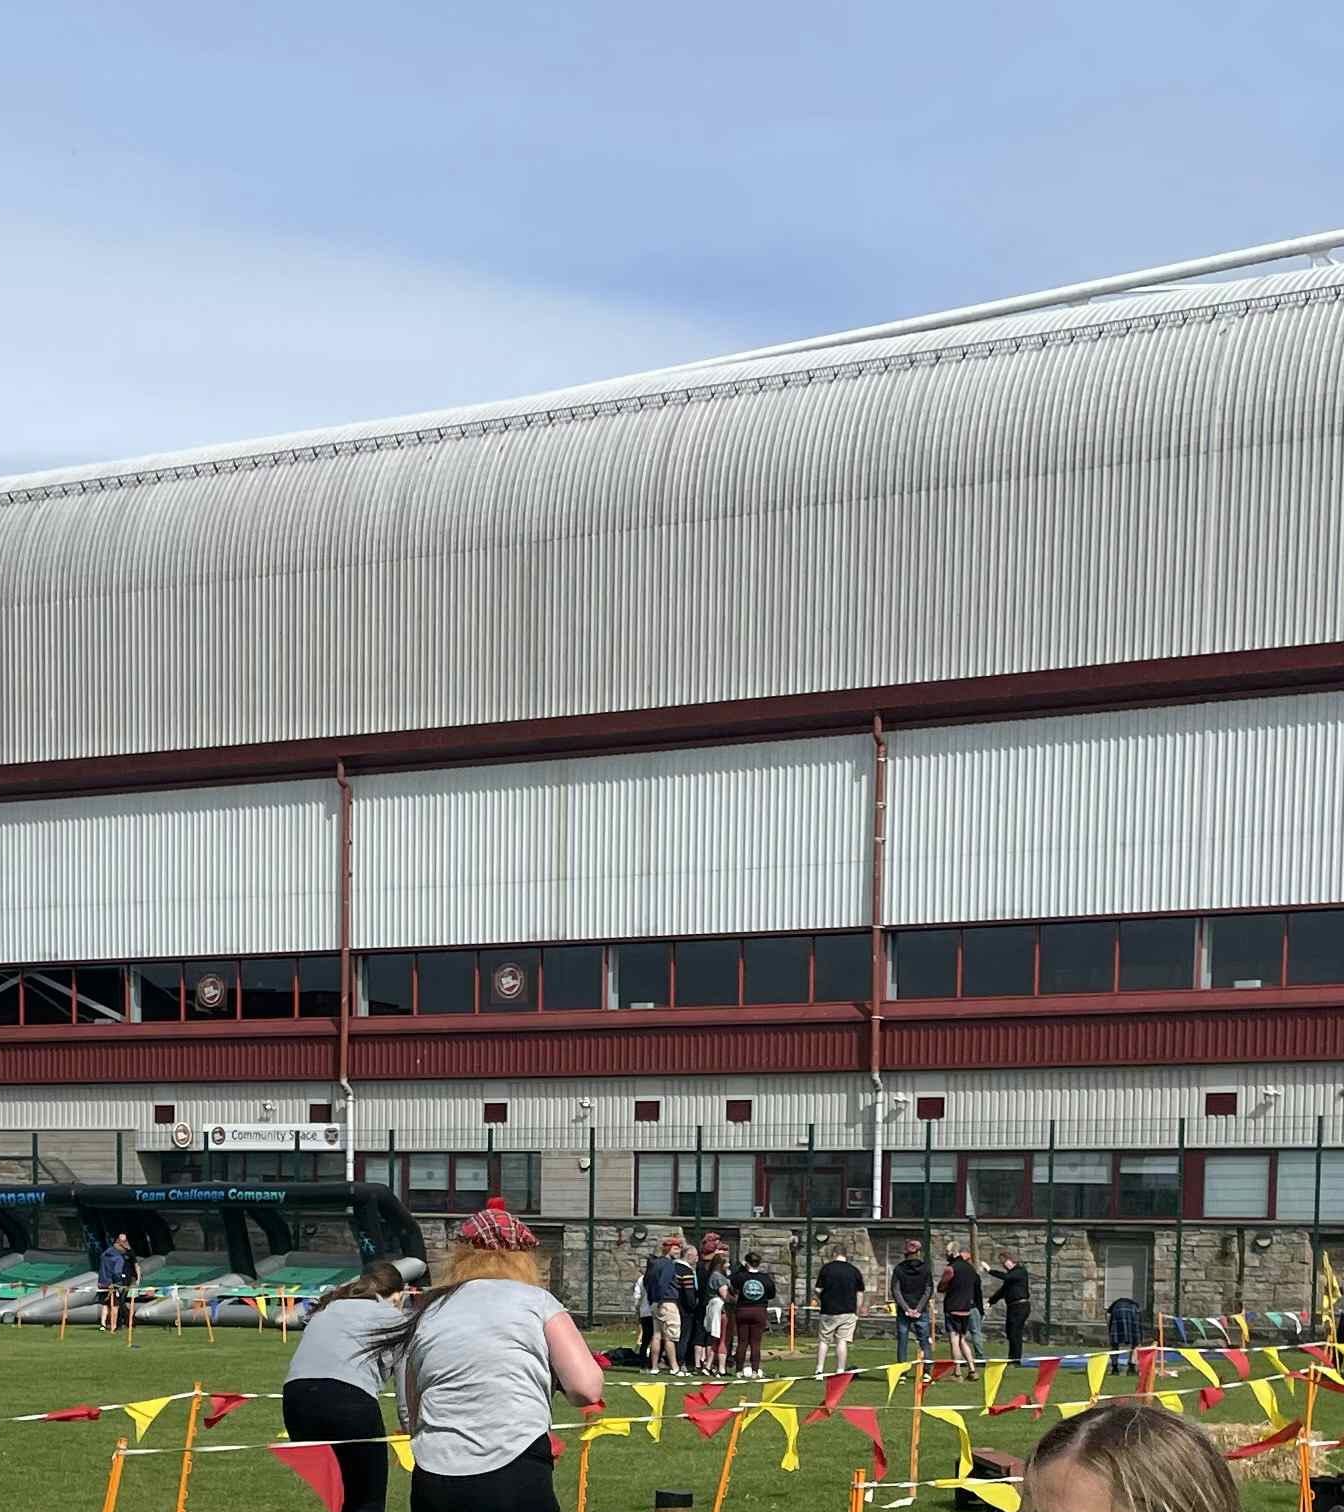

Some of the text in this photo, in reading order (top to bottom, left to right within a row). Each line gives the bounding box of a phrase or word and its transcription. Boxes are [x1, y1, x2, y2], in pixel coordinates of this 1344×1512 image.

[231, 1129, 318, 1143] Community Sace
[135, 1188, 286, 1203] Team Challenge Company
